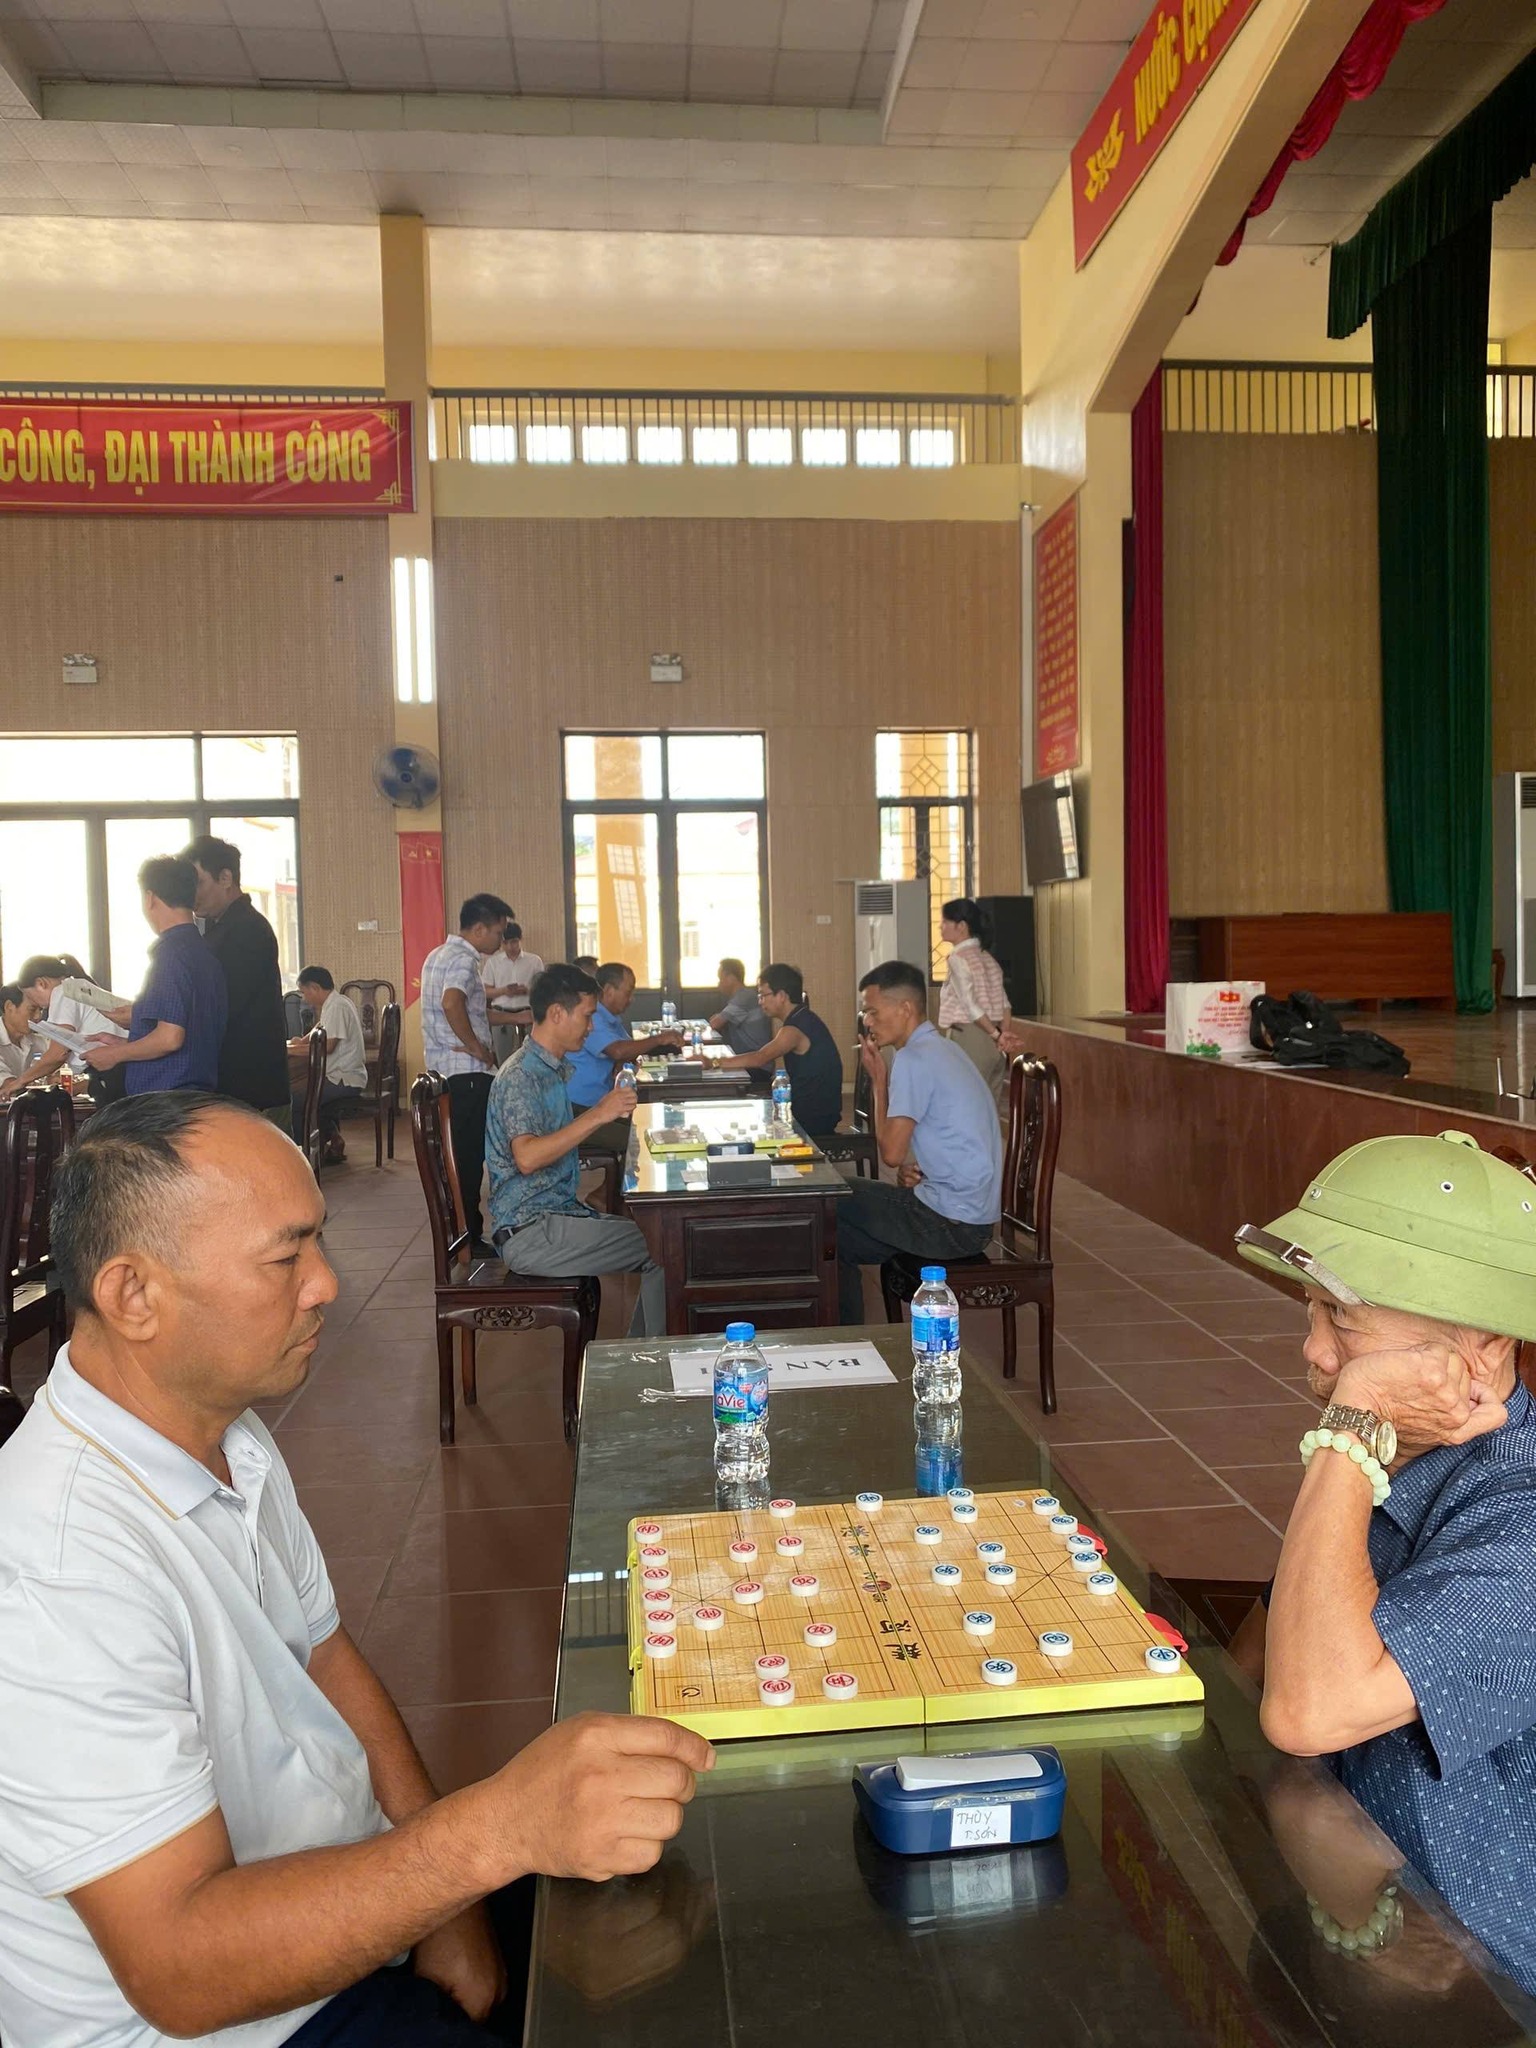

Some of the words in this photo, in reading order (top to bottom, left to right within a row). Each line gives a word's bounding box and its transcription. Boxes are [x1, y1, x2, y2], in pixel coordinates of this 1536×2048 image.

[0, 417, 95, 490] CÔNG,
[104, 430, 159, 495] ĐẠI
[169, 420, 275, 484] THÀNH
[285, 420, 371, 482] CÔNG
